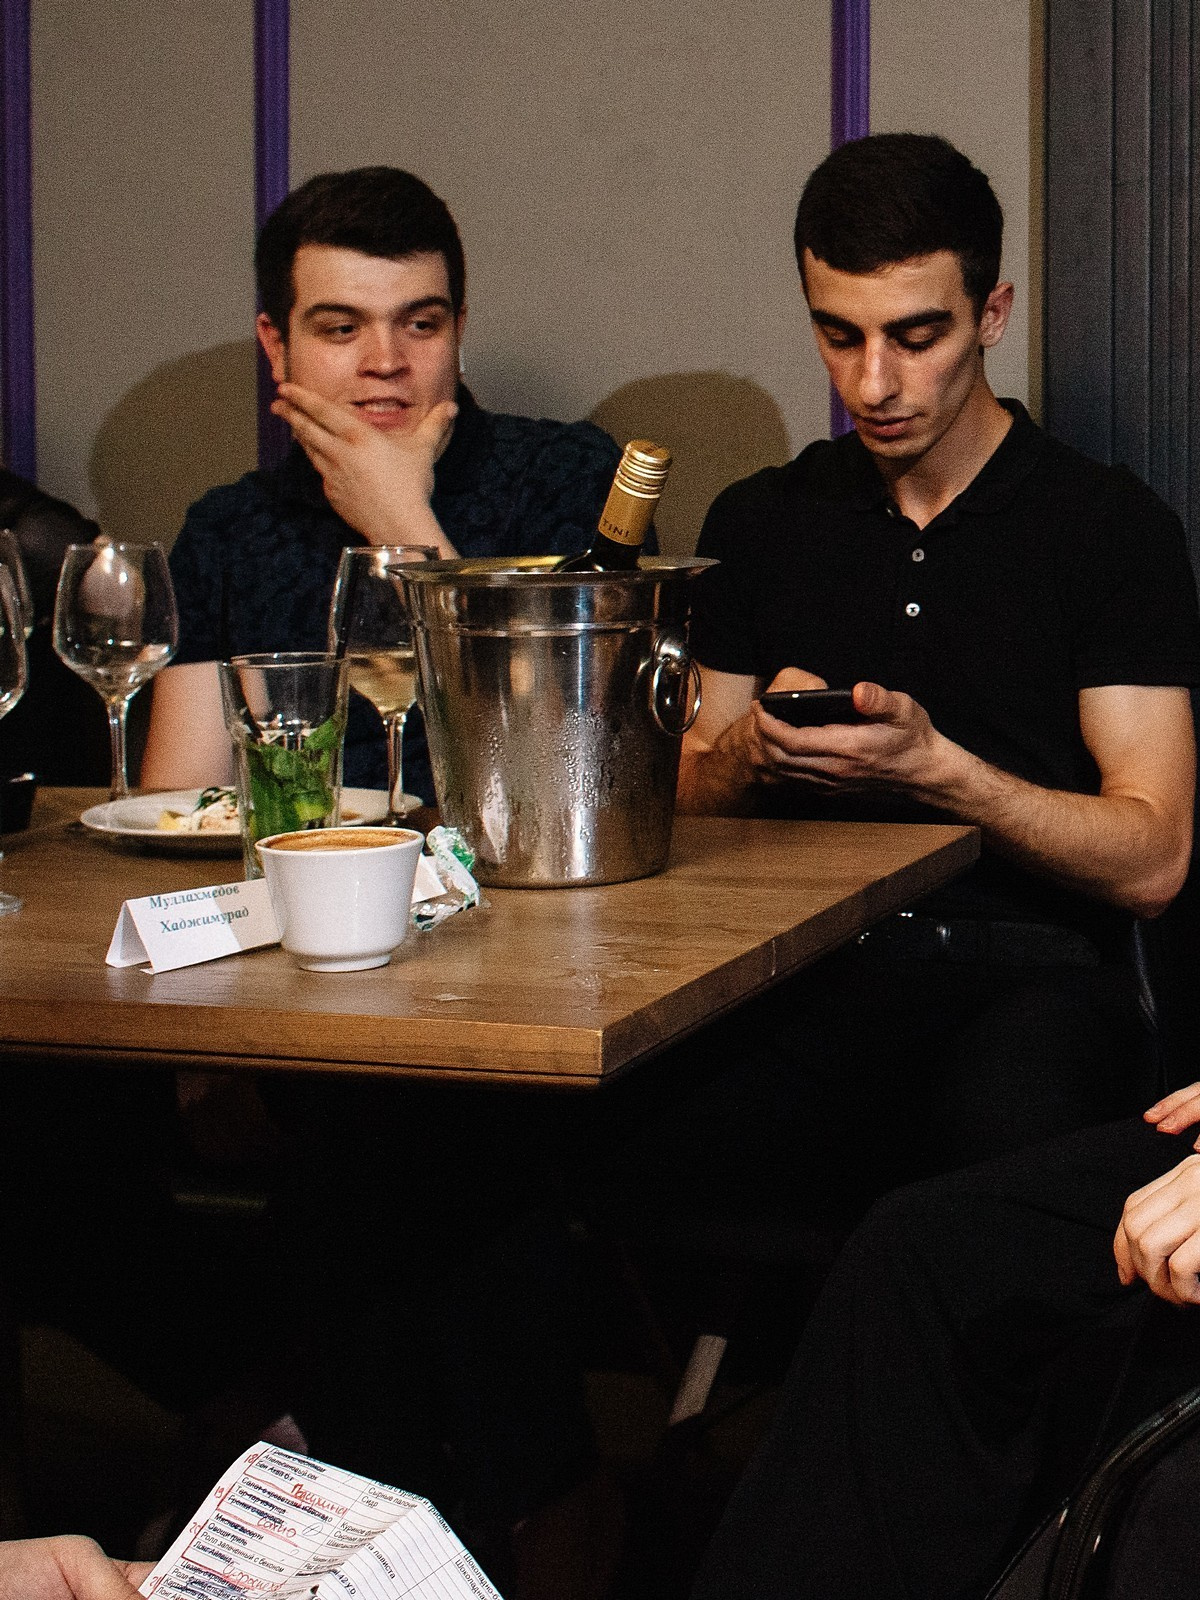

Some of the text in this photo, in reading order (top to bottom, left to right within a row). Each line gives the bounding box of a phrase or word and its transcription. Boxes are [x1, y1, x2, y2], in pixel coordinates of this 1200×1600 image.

[602, 519, 629, 538] TINI
[149, 886, 240, 910] Муллахмедов
[161, 906, 250, 933] Хаджимурад
[361, 1496, 378, 1508] Сидр
[201, 1531, 217, 1544] Ролл
[455, 1559, 486, 1600] Шоколадна
[464, 1553, 500, 1600] Шоколадно-б
